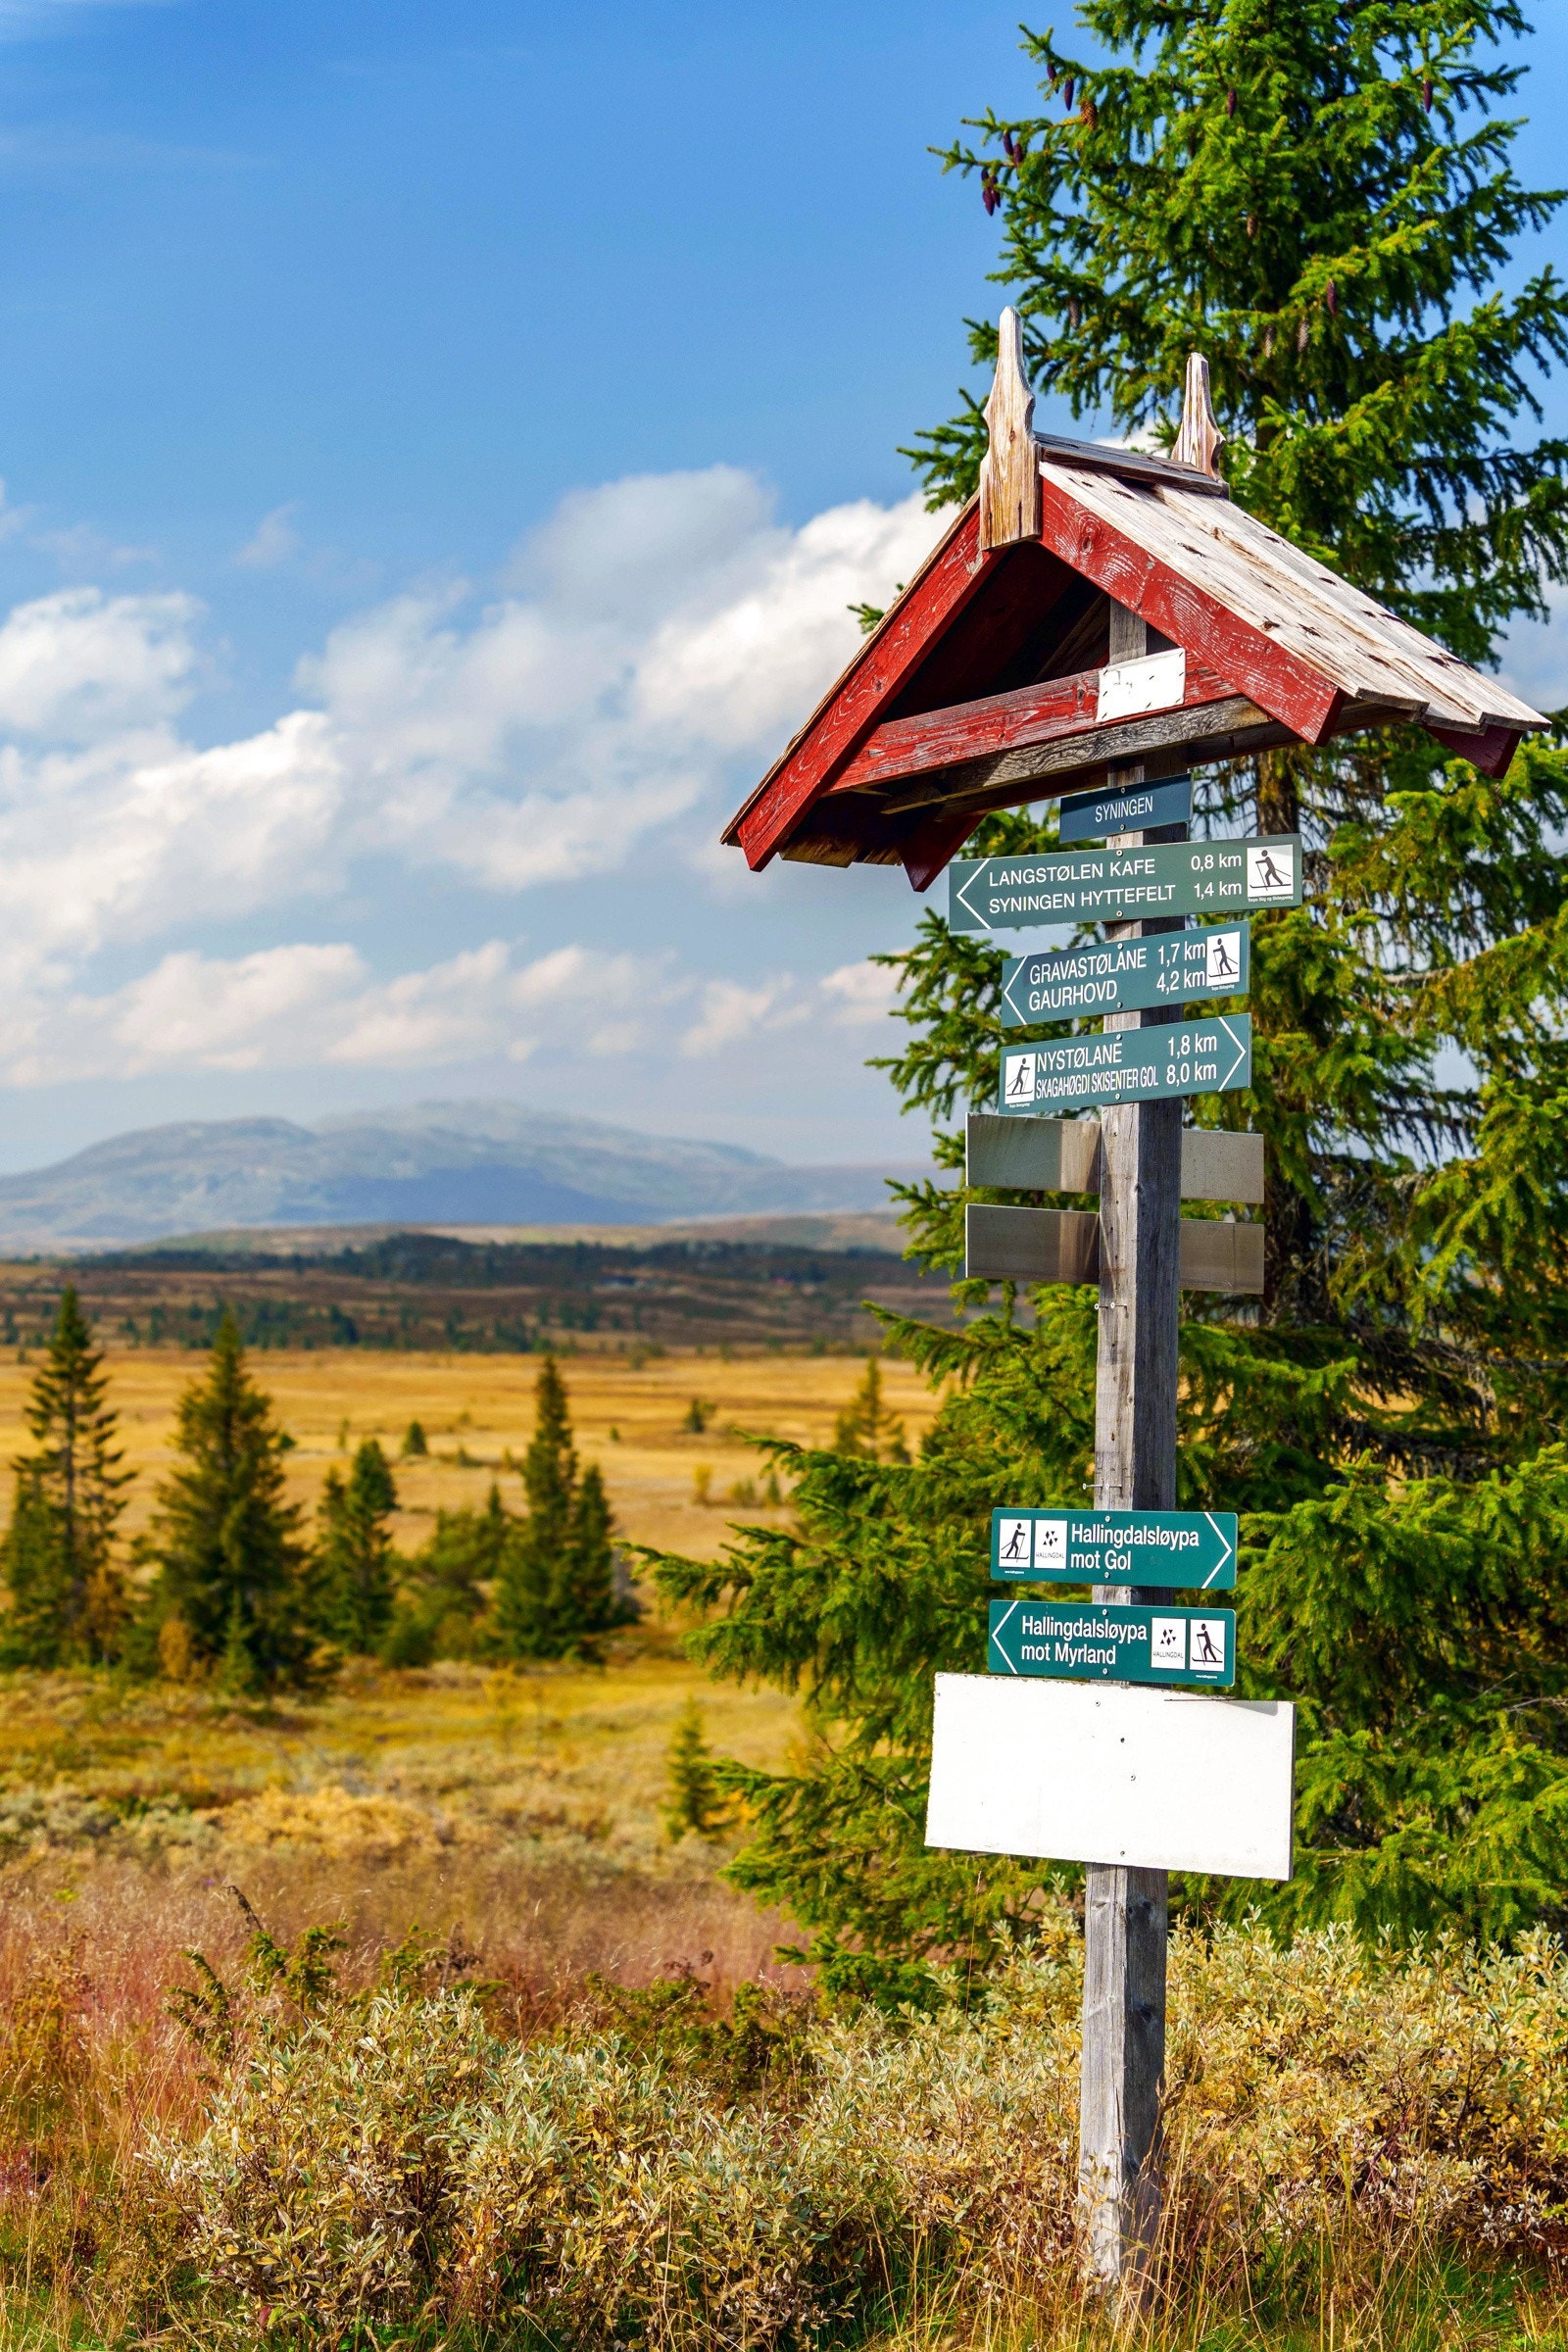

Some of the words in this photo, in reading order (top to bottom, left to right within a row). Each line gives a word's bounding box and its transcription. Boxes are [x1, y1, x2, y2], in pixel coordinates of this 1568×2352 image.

[1095, 796, 1153, 823] SYNINGEN
[989, 863, 1103, 887] LANGSTØLEN
[1109, 858, 1155, 877] KAFE
[1191, 854, 1214, 872] 0,8
[1218, 853, 1242, 868] km
[989, 893, 1075, 914] SYNINGEN
[1081, 884, 1176, 906] HYTTEFELT
[1194, 882, 1214, 900] 1,4
[1218, 881, 1243, 896] km
[1158, 943, 1181, 967] 1,7
[1184, 941, 1206, 960] km
[1156, 970, 1180, 995] 4,2
[1183, 968, 1205, 988] km
[1029, 980, 1118, 1011] GAURHOVD
[1037, 1043, 1123, 1072] NYSTØLANE
[1168, 1035, 1191, 1059] 1,8
[1195, 1033, 1217, 1054] km
[1036, 1074, 1090, 1100] SKAGAHØGDI
[1091, 1068, 1139, 1093] SKISENTER
[1140, 1066, 1159, 1088] GOL
[1166, 1062, 1190, 1087] 8,0
[1194, 1061, 1217, 1081] km
[1071, 1523, 1200, 1550] Hallingdalsløypa
[1071, 1552, 1101, 1569] mot
[1104, 1549, 1132, 1570] Gol
[1021, 1615, 1148, 1644] Hallingdalsløypa
[1021, 1643, 1051, 1660] mot
[1054, 1642, 1116, 1667] Myrland
